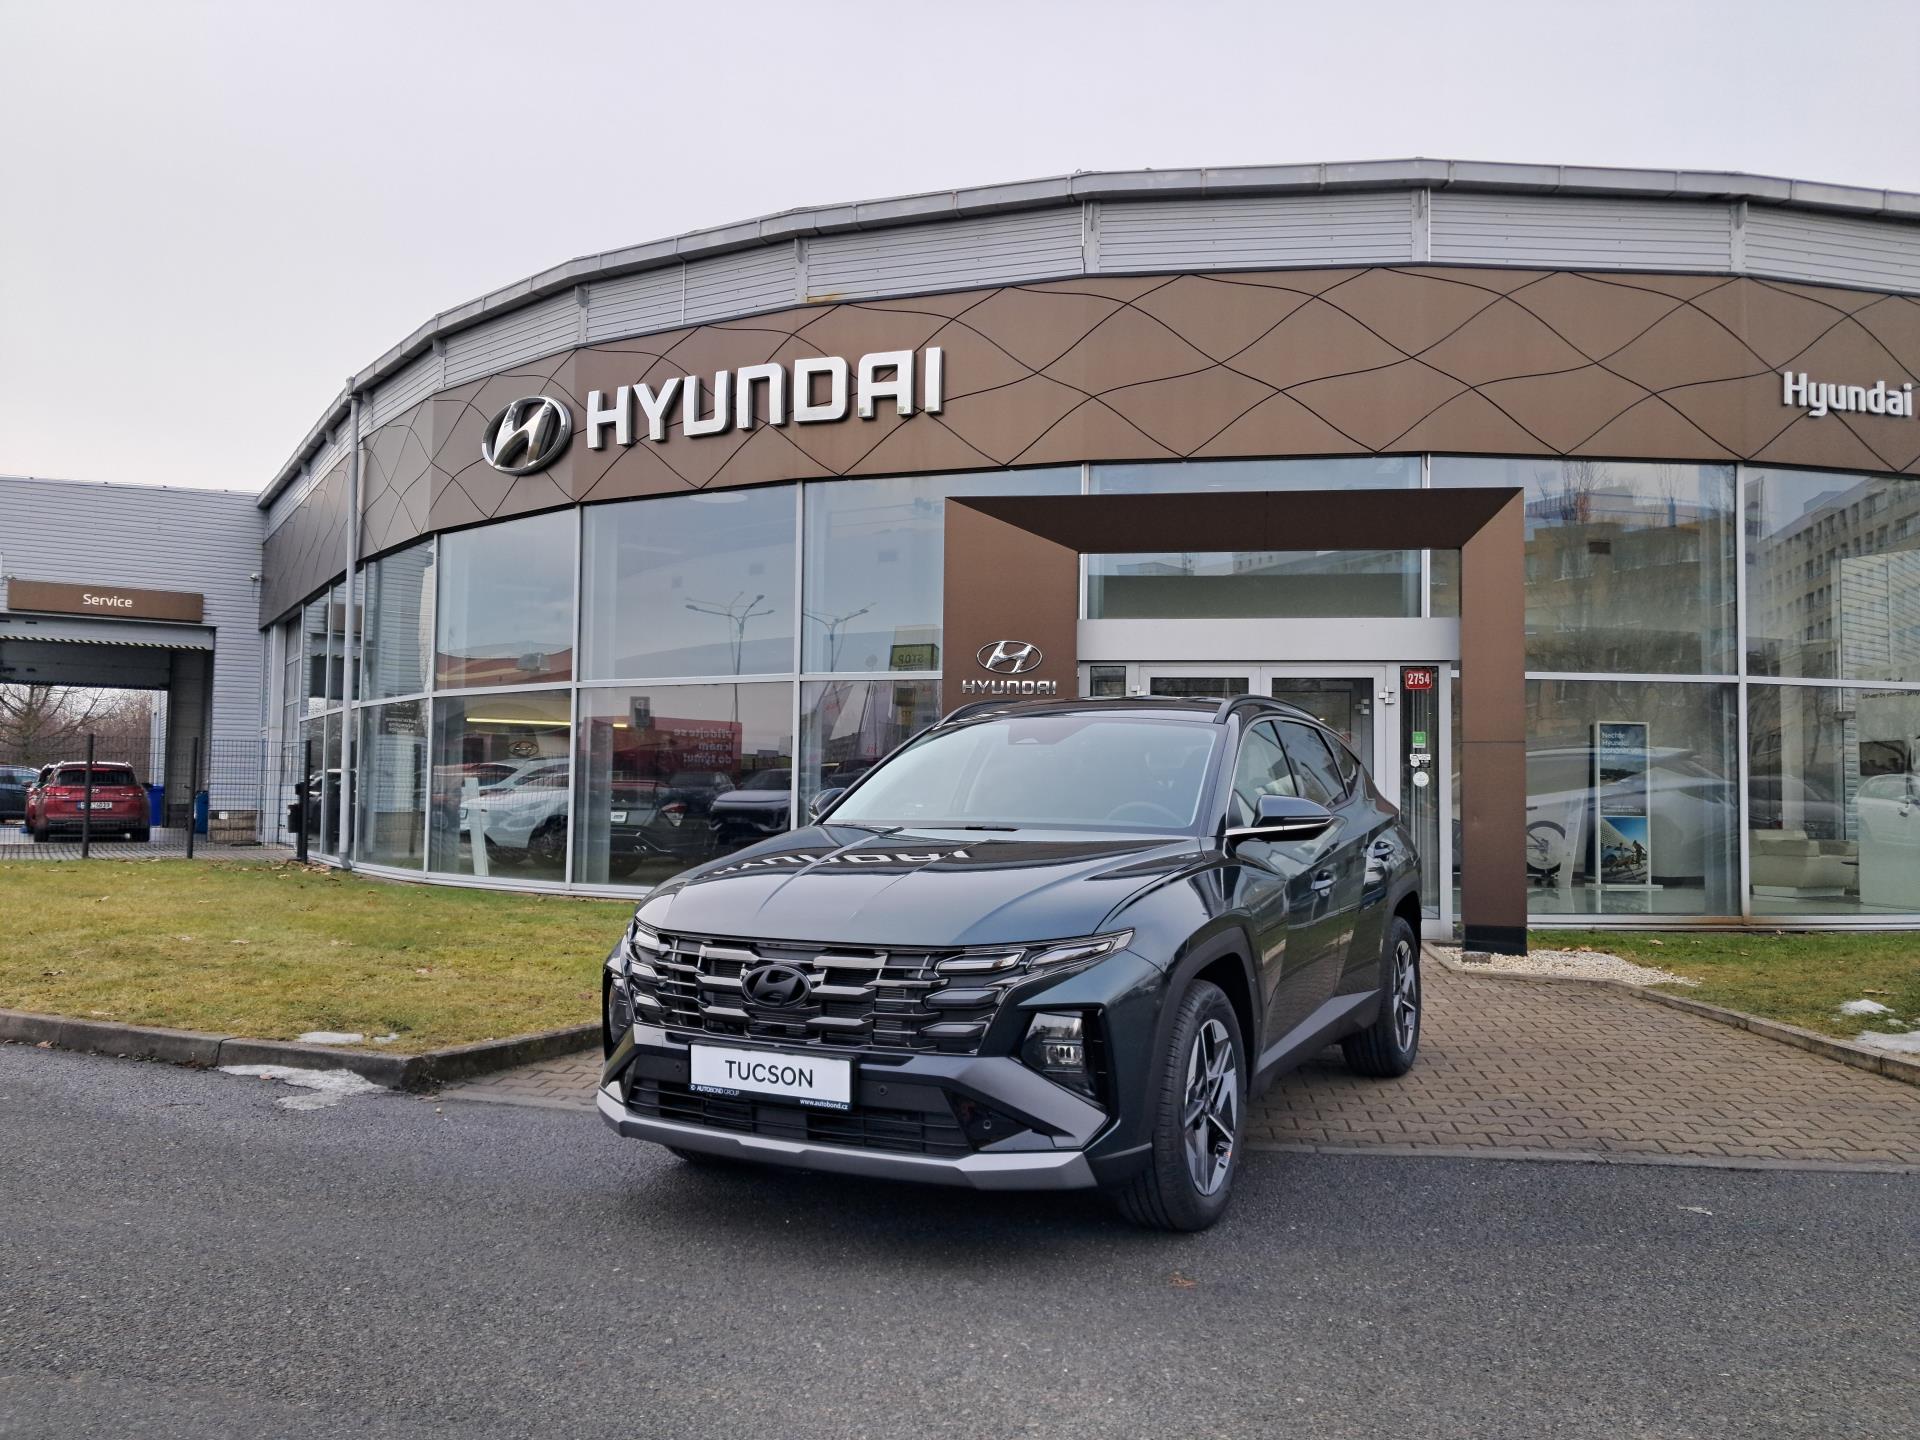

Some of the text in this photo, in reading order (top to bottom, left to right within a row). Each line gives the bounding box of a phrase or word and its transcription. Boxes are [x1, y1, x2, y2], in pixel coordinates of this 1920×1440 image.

[586, 347, 943, 450] HYUNDAI
[1783, 371, 1913, 416] Hyundai
[82, 593, 133, 608] Service
[1407, 673, 1431, 685] 2754
[962, 680, 1057, 695] HYUNDAI
[724, 1060, 813, 1088] TUCSON
[697, 1085, 724, 1095] AUTOBOND
[799, 1099, 848, 1111] www.autobond.cz
